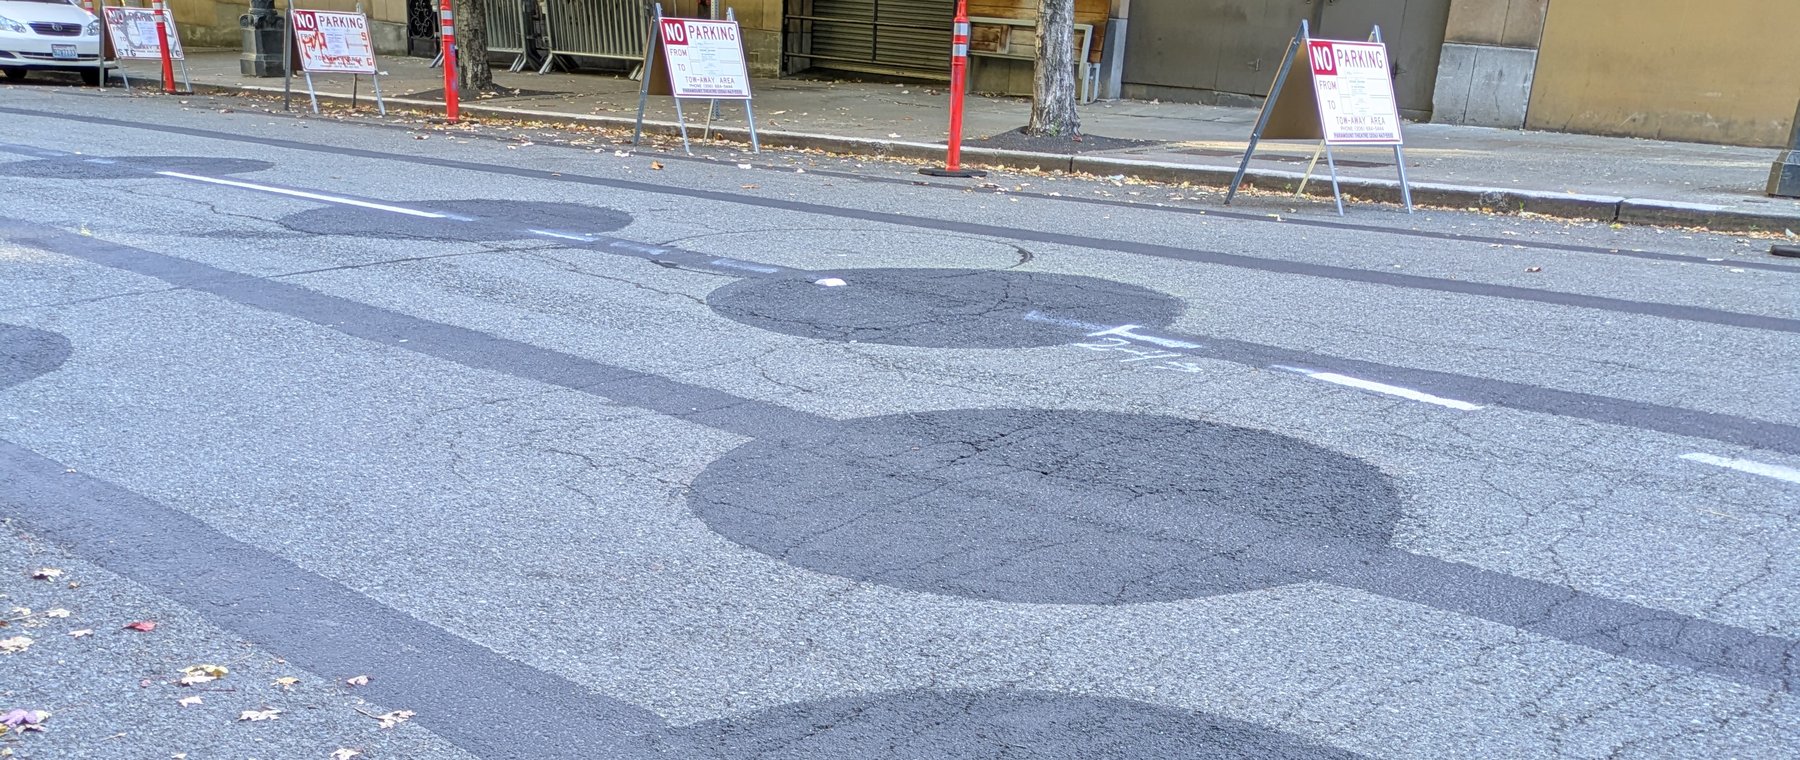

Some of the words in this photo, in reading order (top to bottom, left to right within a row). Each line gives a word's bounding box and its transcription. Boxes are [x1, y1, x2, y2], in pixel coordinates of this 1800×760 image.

[297, 13, 314, 29] NO
[319, 15, 363, 29] PARKING
[664, 23, 684, 42] NO
[688, 25, 735, 41] PARKING
[669, 48, 688, 57] FROM
[1312, 46, 1333, 71] NO
[1336, 49, 1383, 69] PARKING
[677, 63, 686, 72] TO
[685, 75, 714, 84] TOW-AWAY
[719, 76, 735, 84] AREA
[1319, 80, 1337, 90] FROM
[1327, 99, 1336, 110] TO
[1336, 116, 1366, 125] TOW-AWAY
[1370, 116, 1386, 125] AREA
